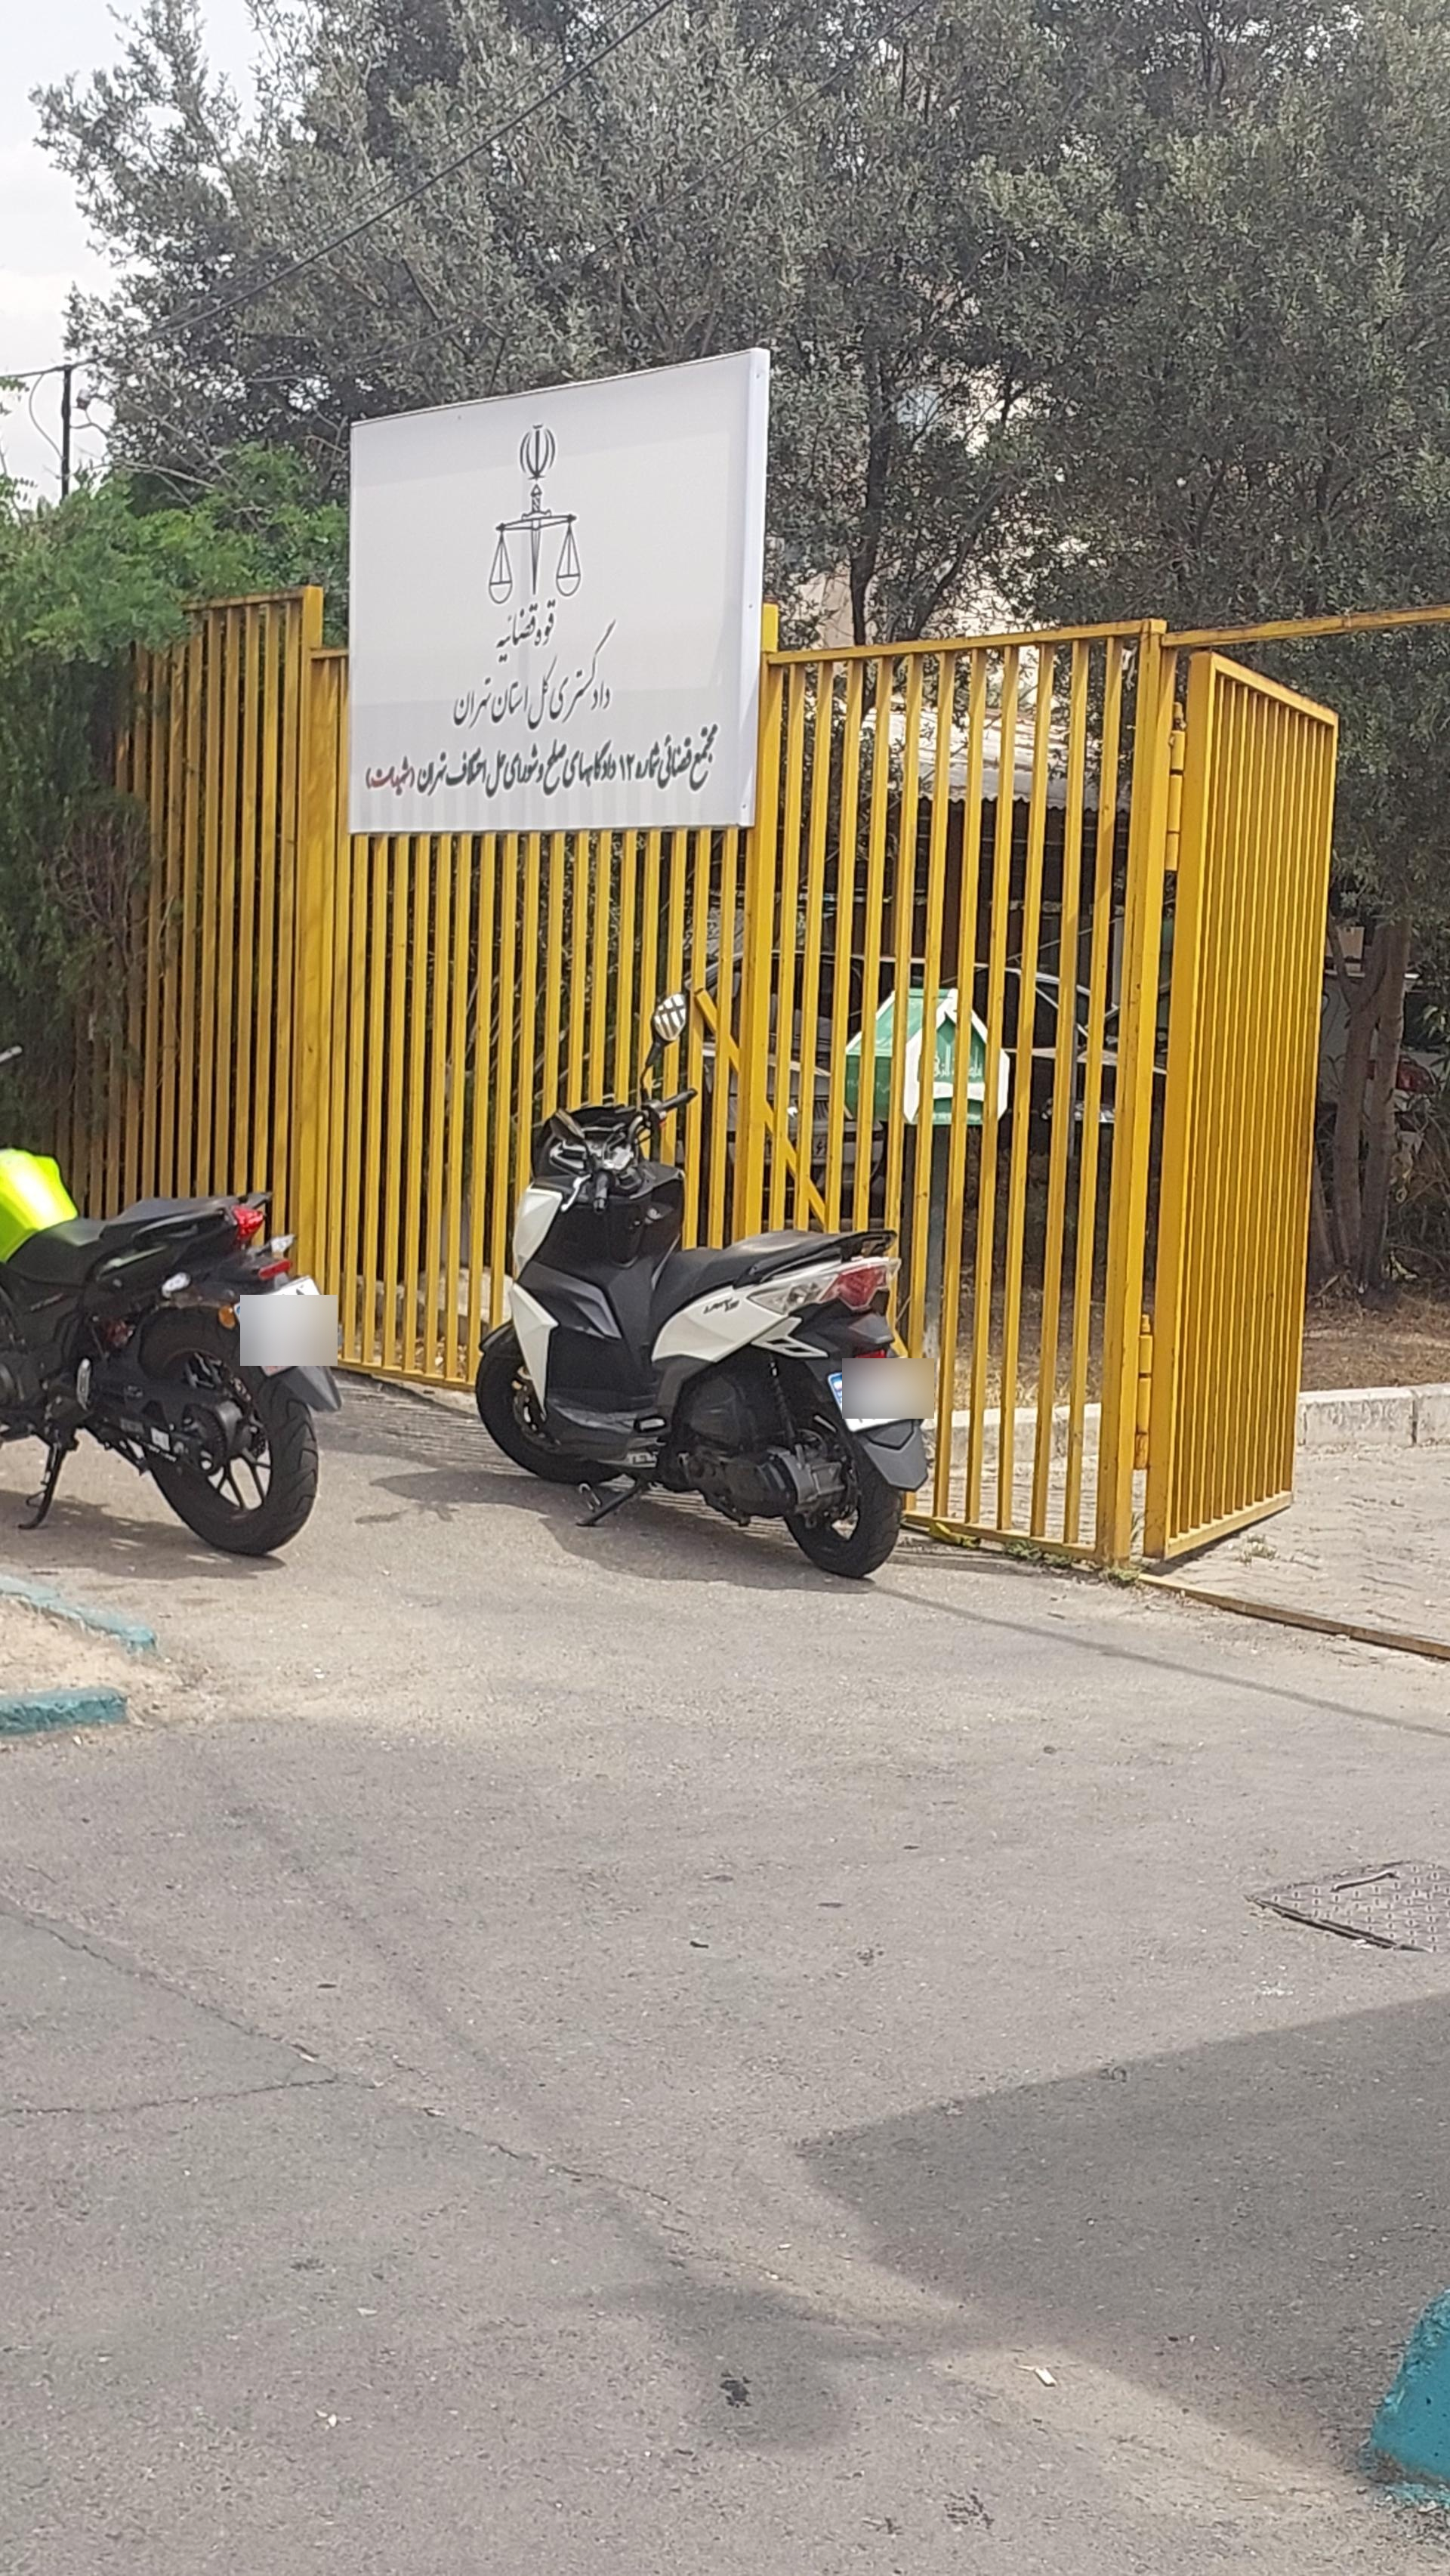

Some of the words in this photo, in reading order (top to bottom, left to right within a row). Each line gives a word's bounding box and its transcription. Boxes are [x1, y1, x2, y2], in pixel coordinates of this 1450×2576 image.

[534, 599, 556, 646] قوه
[528, 654, 557, 730] کل
[549, 619, 615, 724] دادگستری
[453, 677, 492, 729] تهران
[492, 680, 529, 724] استان
[417, 751, 448, 797] تهران
[446, 746, 487, 786] اختلاف
[486, 749, 508, 798] حل
[503, 743, 539, 791] شورای
[535, 762, 545, 783] و
[543, 737, 568, 796] صلح
[635, 740, 661, 779] شماره
[689, 723, 718, 791] مجتمع
